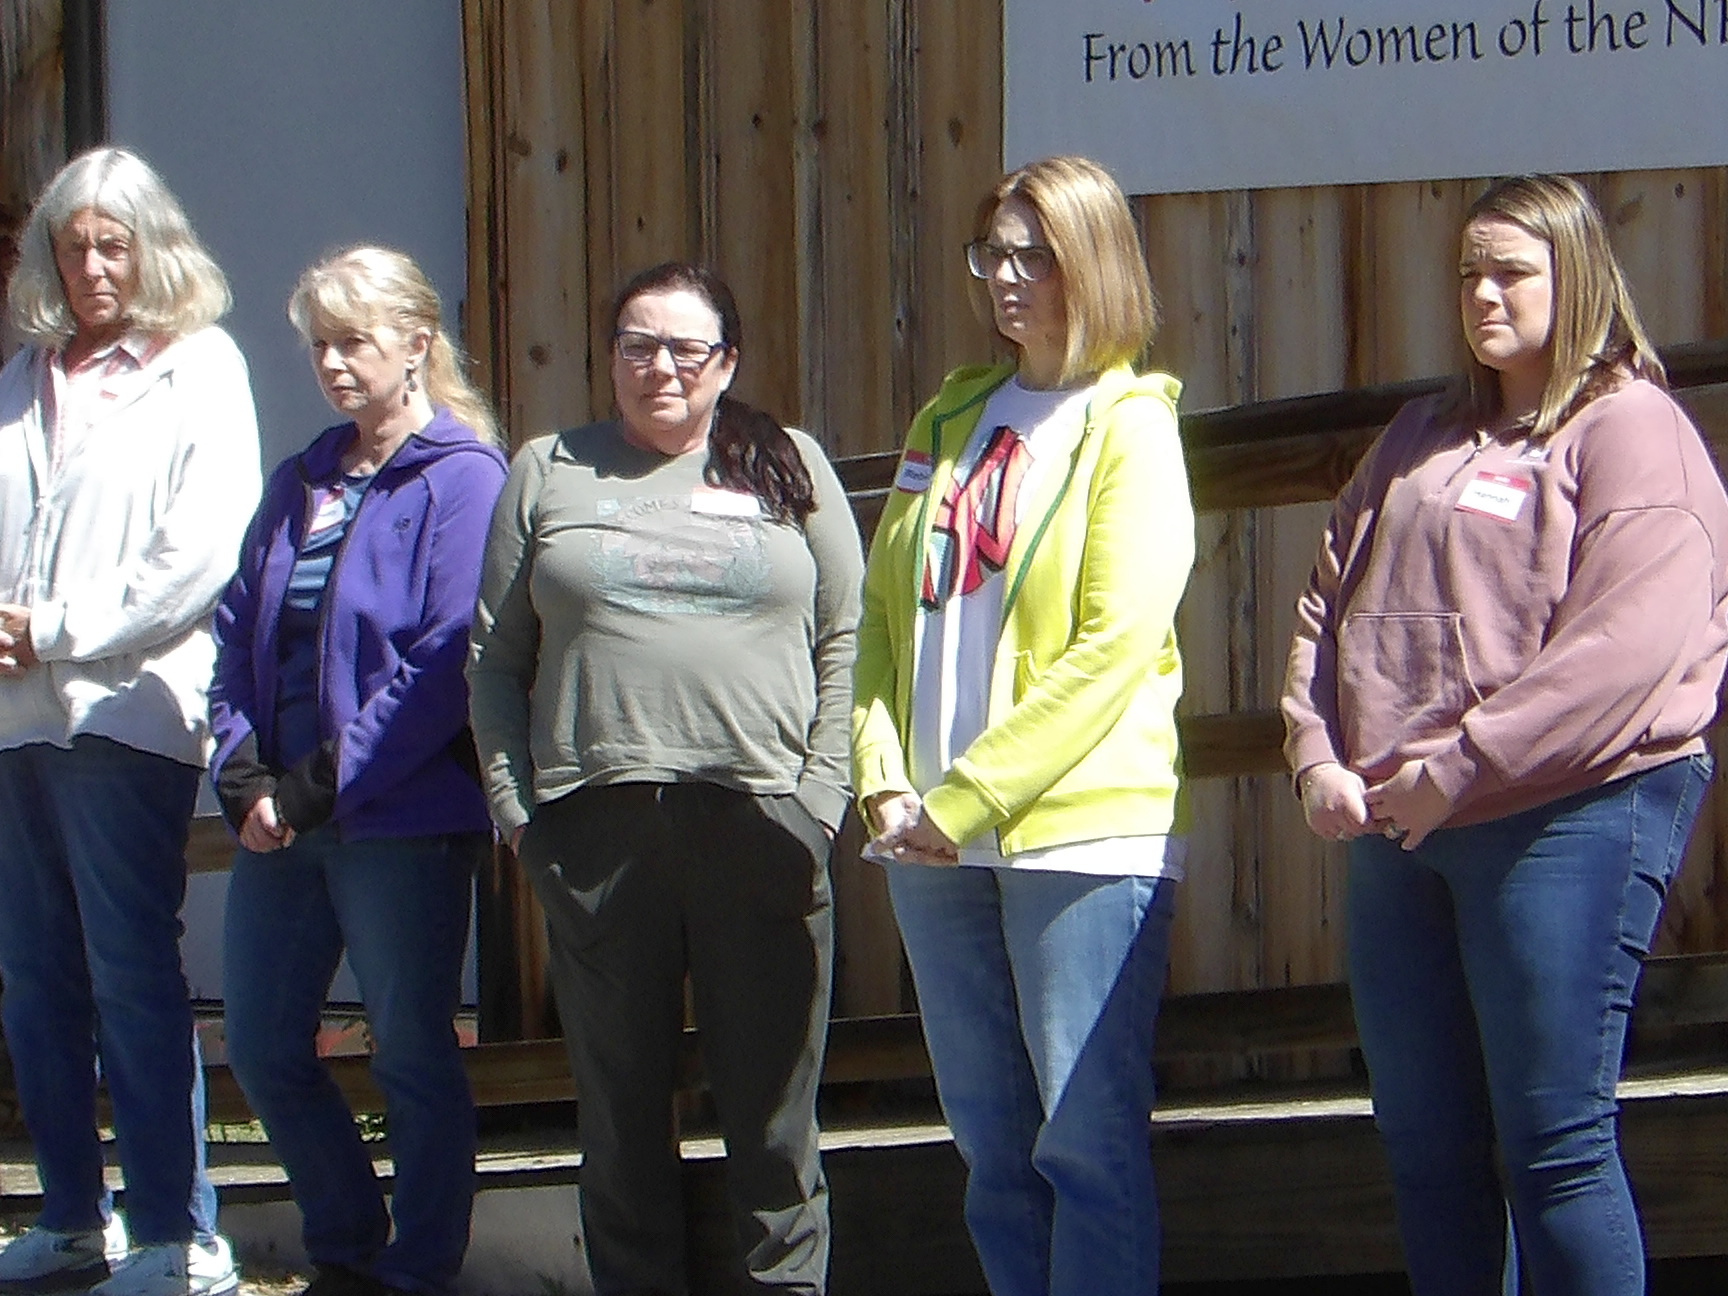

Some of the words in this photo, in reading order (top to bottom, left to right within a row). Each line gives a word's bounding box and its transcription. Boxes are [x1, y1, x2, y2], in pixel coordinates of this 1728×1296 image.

[1082, 31, 1197, 83] From
[1209, 11, 1284, 76] the
[1296, 16, 1485, 71] Women
